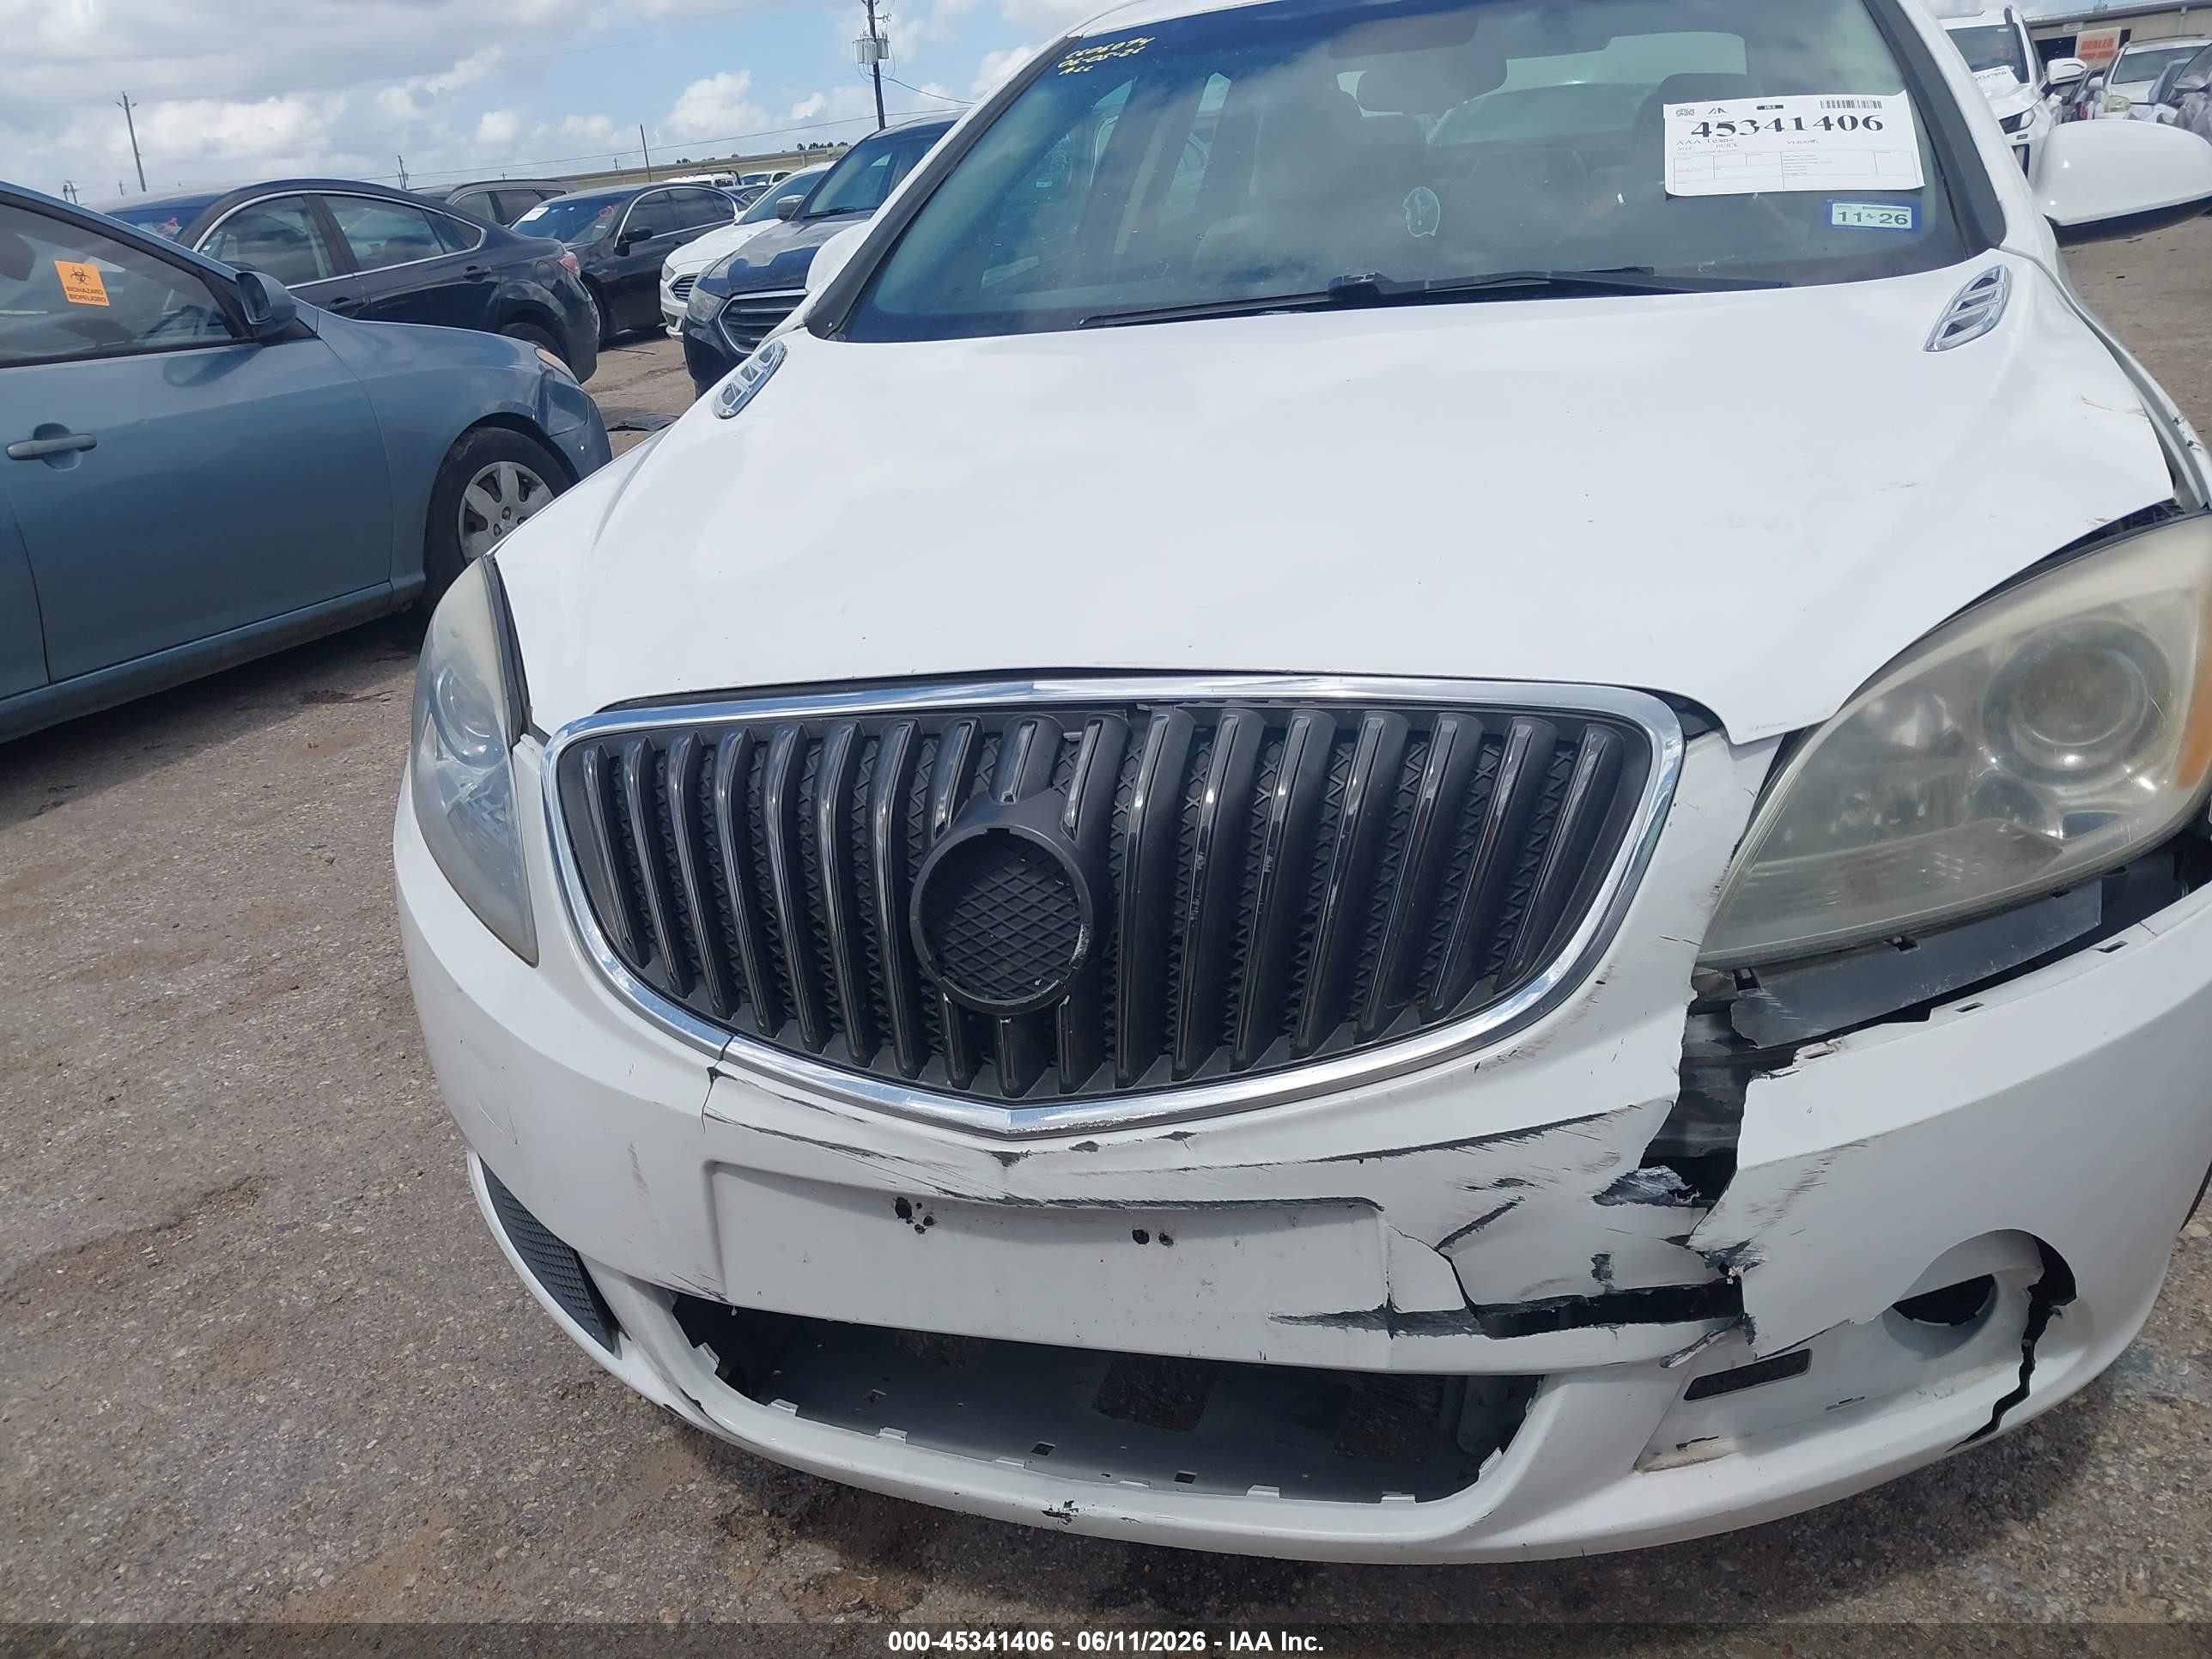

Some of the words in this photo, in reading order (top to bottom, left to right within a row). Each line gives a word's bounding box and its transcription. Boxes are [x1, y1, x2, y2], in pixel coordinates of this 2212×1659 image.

[1691, 114, 1884, 137] 45341406
[1838, 211, 1863, 222] 11
[1879, 213, 1909, 225] 26
[66, 286, 104, 295] BIOHAZARD
